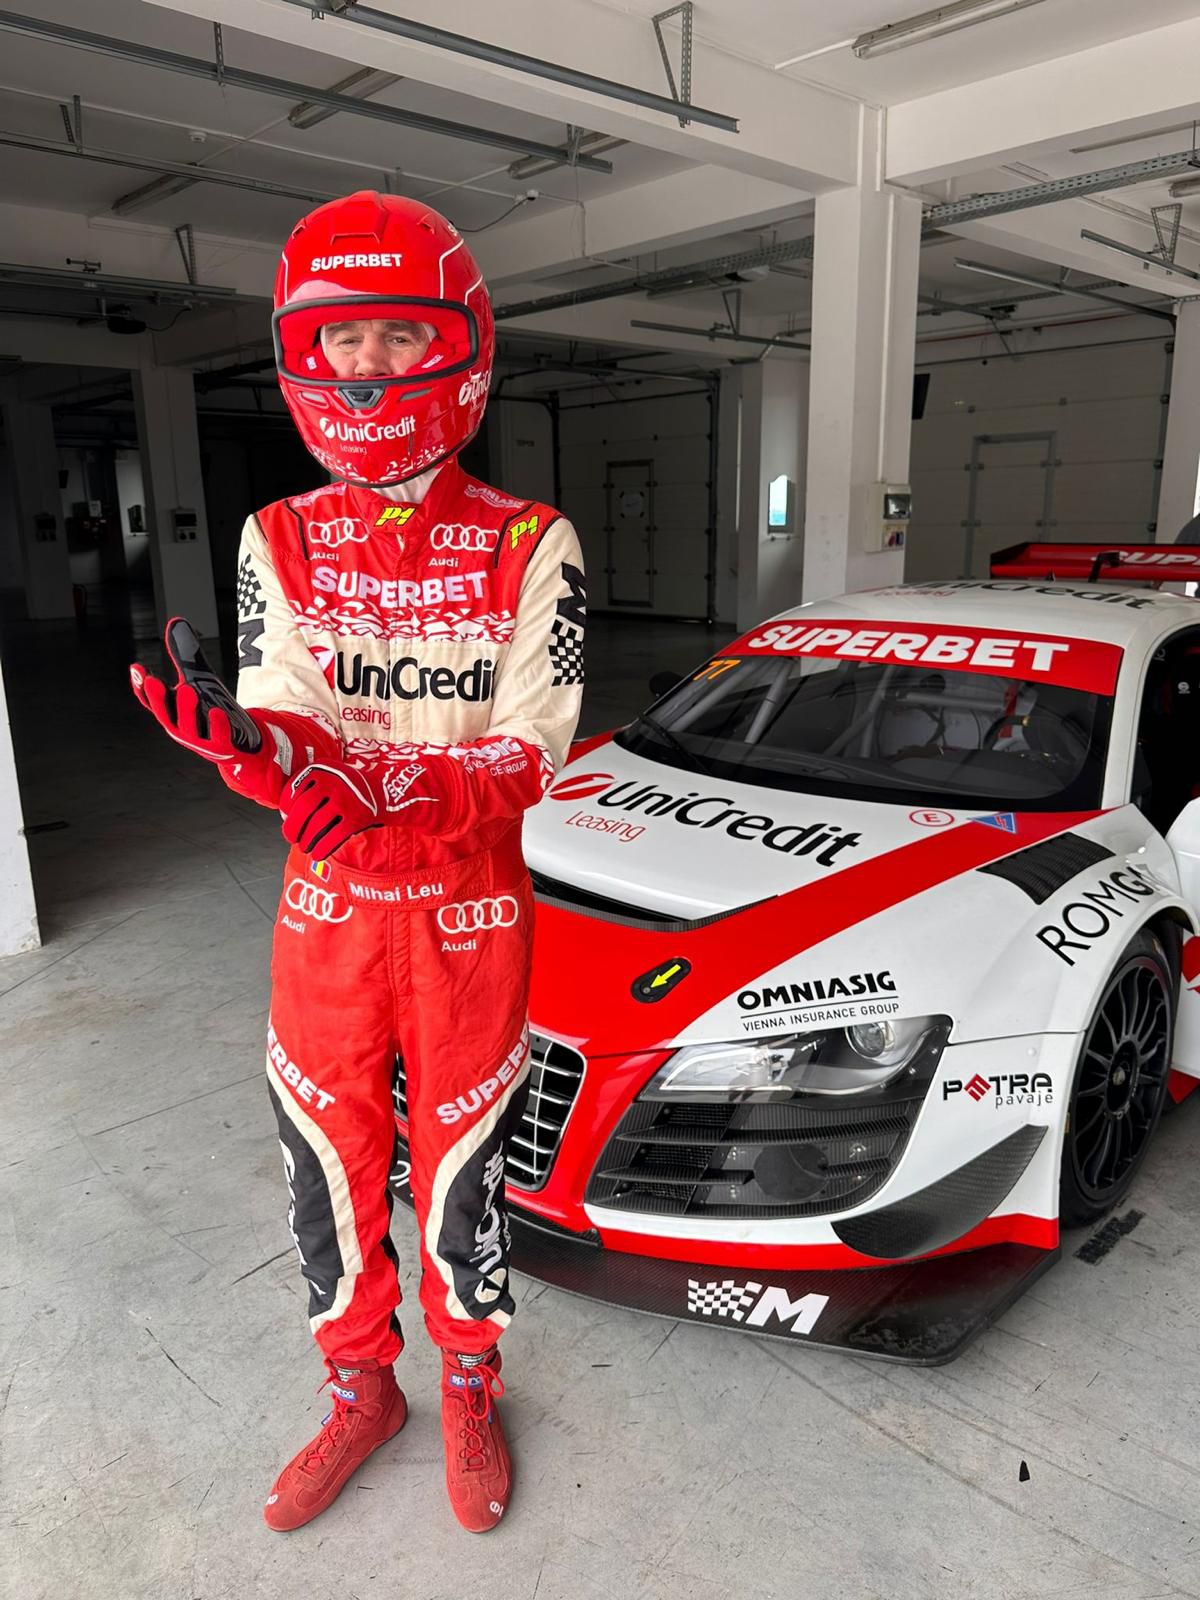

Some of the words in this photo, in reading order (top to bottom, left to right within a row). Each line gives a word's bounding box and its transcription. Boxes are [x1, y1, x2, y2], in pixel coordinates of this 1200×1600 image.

[310, 253, 402, 271] SUPERBET
[337, 415, 416, 442] UniCredit
[374, 507, 416, 527] P1
[509, 515, 539, 550] P1
[309, 551, 340, 562] Audi
[428, 557, 459, 568] Audi
[312, 566, 487, 608] SUPERBET
[748, 624, 1069, 671] SUPERBET
[337, 651, 497, 702] UniCredi
[339, 705, 391, 730] easing
[565, 810, 646, 842] Leasing
[597, 781, 862, 866] UniCredit
[350, 882, 400, 901] Mihai
[407, 882, 444, 899] Leu
[281, 914, 306, 933] Audi
[441, 939, 477, 952] Audi
[737, 970, 896, 1010] OMNIASIG
[743, 1017, 786, 1031] VIENNA
[790, 1007, 856, 1025] INSURANCE
[860, 1003, 899, 1016] GROUP
[995, 1091, 1053, 1109] pavaje
